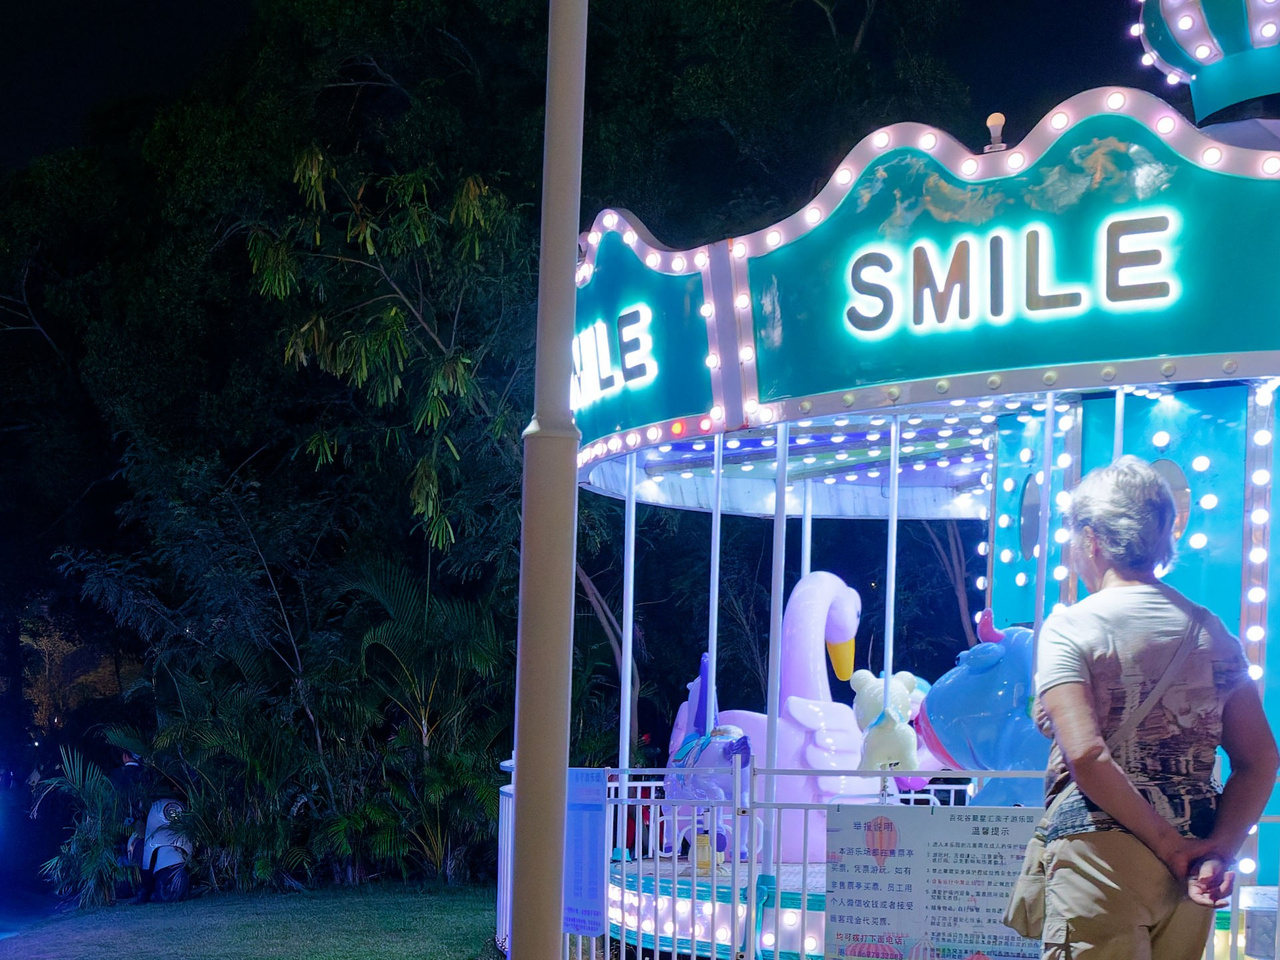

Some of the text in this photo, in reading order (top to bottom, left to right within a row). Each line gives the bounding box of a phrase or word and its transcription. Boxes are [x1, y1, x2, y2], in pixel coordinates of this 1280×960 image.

[845, 215, 1171, 332] SMILE
[853, 821, 893, 832] 举报说明
[972, 827, 1009, 836] 温馨提示
